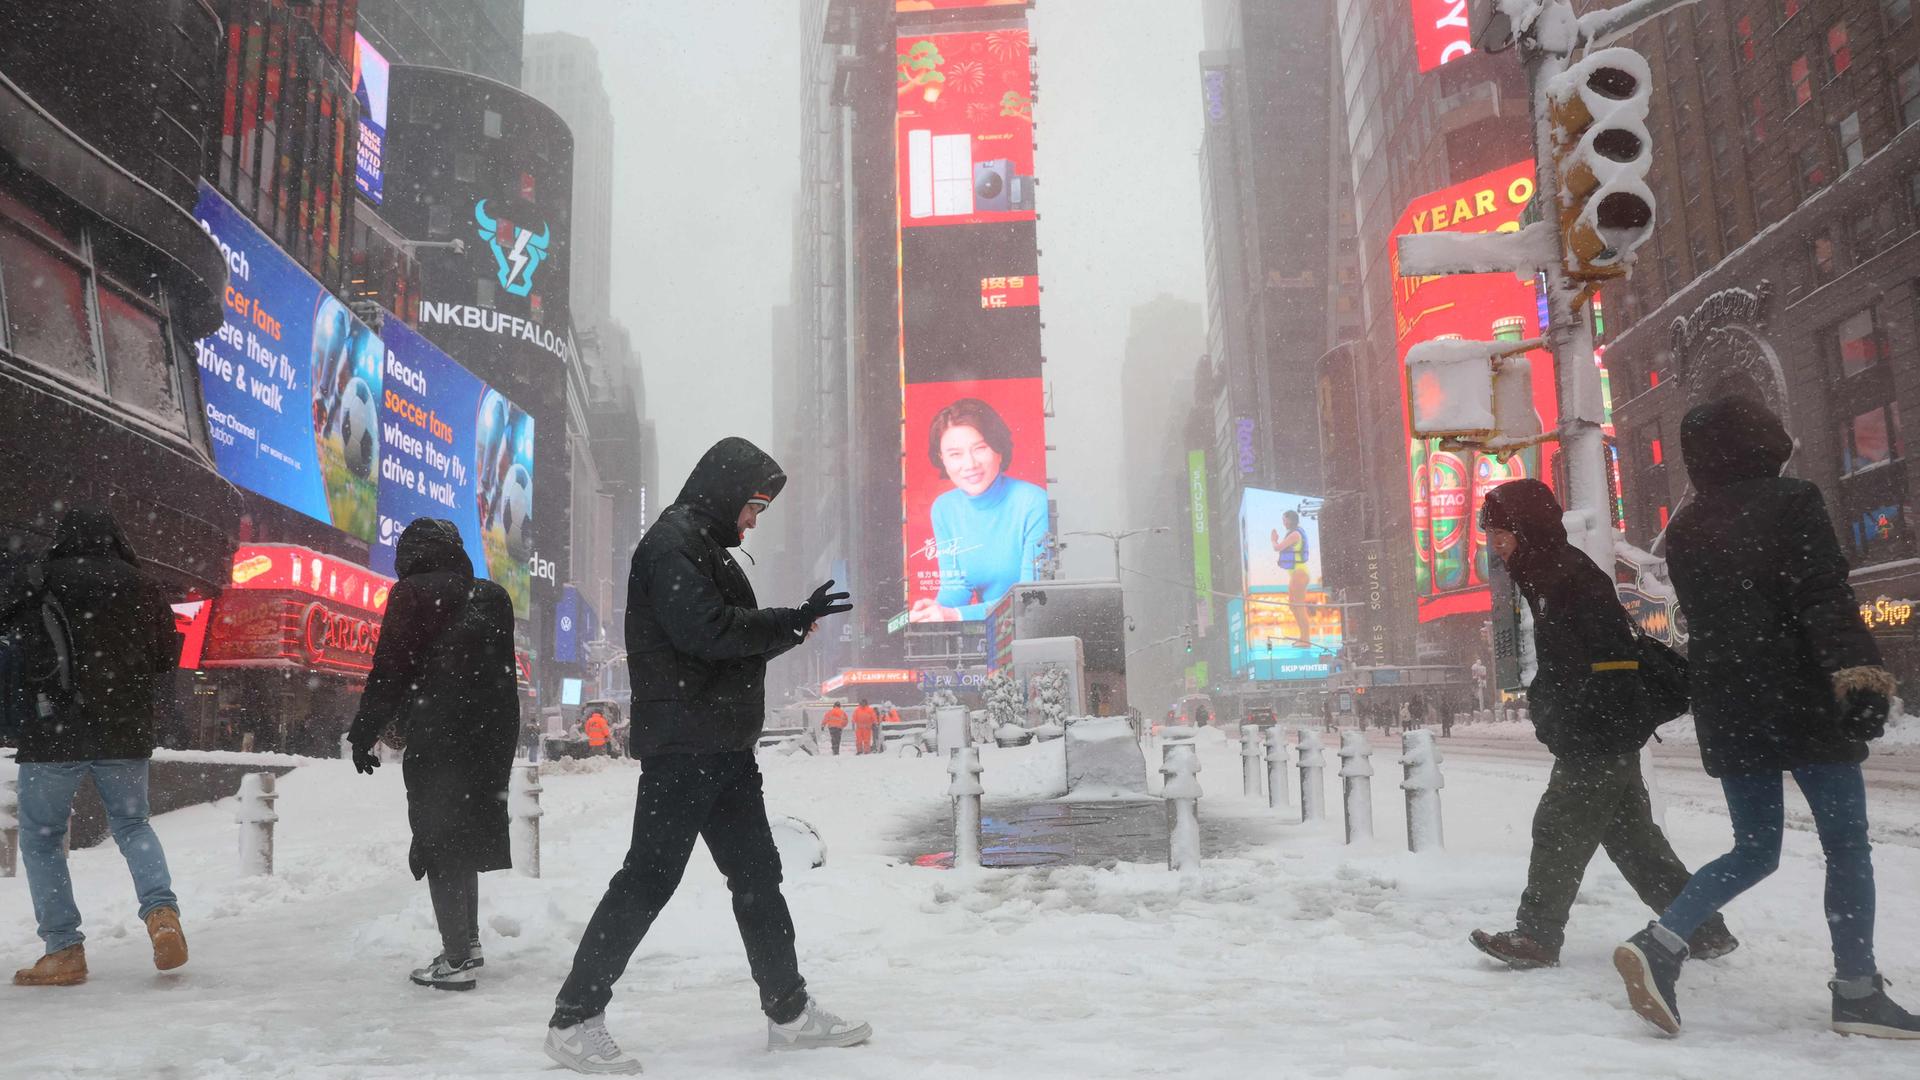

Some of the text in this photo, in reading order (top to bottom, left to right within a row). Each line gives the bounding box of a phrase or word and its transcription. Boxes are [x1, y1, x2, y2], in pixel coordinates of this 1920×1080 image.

[1412, 189, 1497, 235] YEAR
[252, 299, 282, 341] fans
[247, 331, 278, 378] they
[280, 353, 297, 390] fly,
[387, 349, 427, 397] Reach
[236, 364, 246, 392] &
[250, 376, 283, 414] walk
[206, 403, 256, 441] Clear Channel
[385, 389, 453, 445] soccer fans
[383, 422, 468, 487] where they fly,
[382, 454, 456, 509] drive & walk
[529, 551, 555, 587] daq
[1366, 552, 1384, 667] TIMES SQUARE
[1875, 600, 1910, 626] Shop
[1281, 664, 1328, 672] SKIP WINTER
